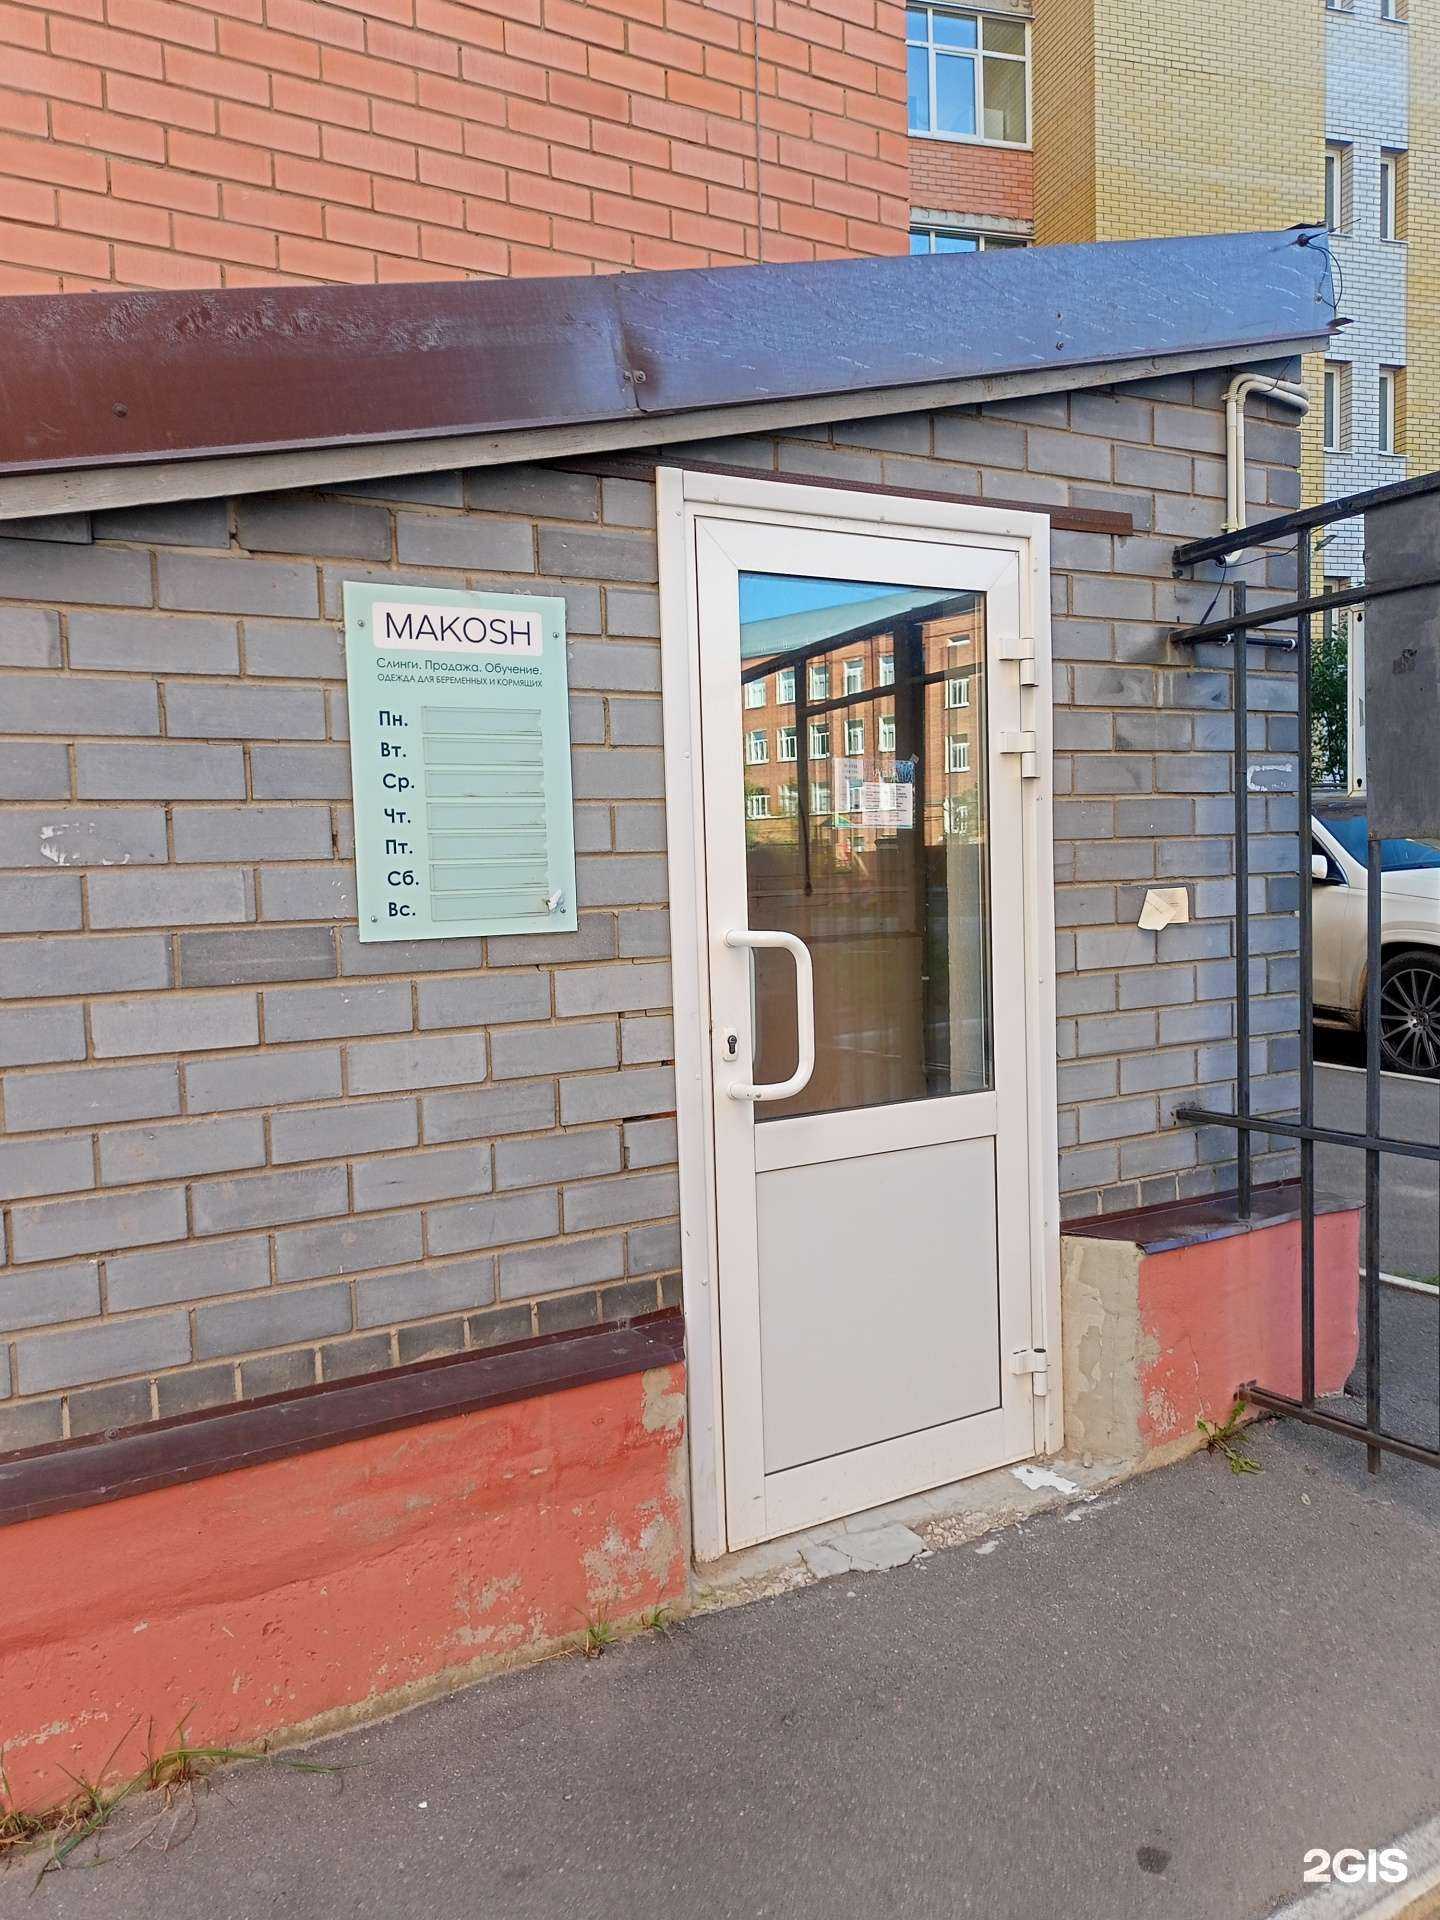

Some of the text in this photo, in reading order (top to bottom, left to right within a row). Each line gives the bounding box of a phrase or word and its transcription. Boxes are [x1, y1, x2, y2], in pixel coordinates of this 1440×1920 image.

[385, 612, 531, 646] MAKOSH
[376, 657, 543, 676] Слинги. Продажа. Обучение.
[377, 673, 543, 688] ОДЕЖДА ДЛЯ БЕРЕМЕННЫХ И КОРМЯЩИХ
[379, 711, 408, 728] Пн.
[381, 742, 407, 758] Вт.
[382, 774, 415, 793] Ср.
[384, 808, 411, 824] Чт.
[385, 840, 413, 855] Пт.
[387, 870, 419, 887] Сб.
[388, 902, 416, 917] Вс.
